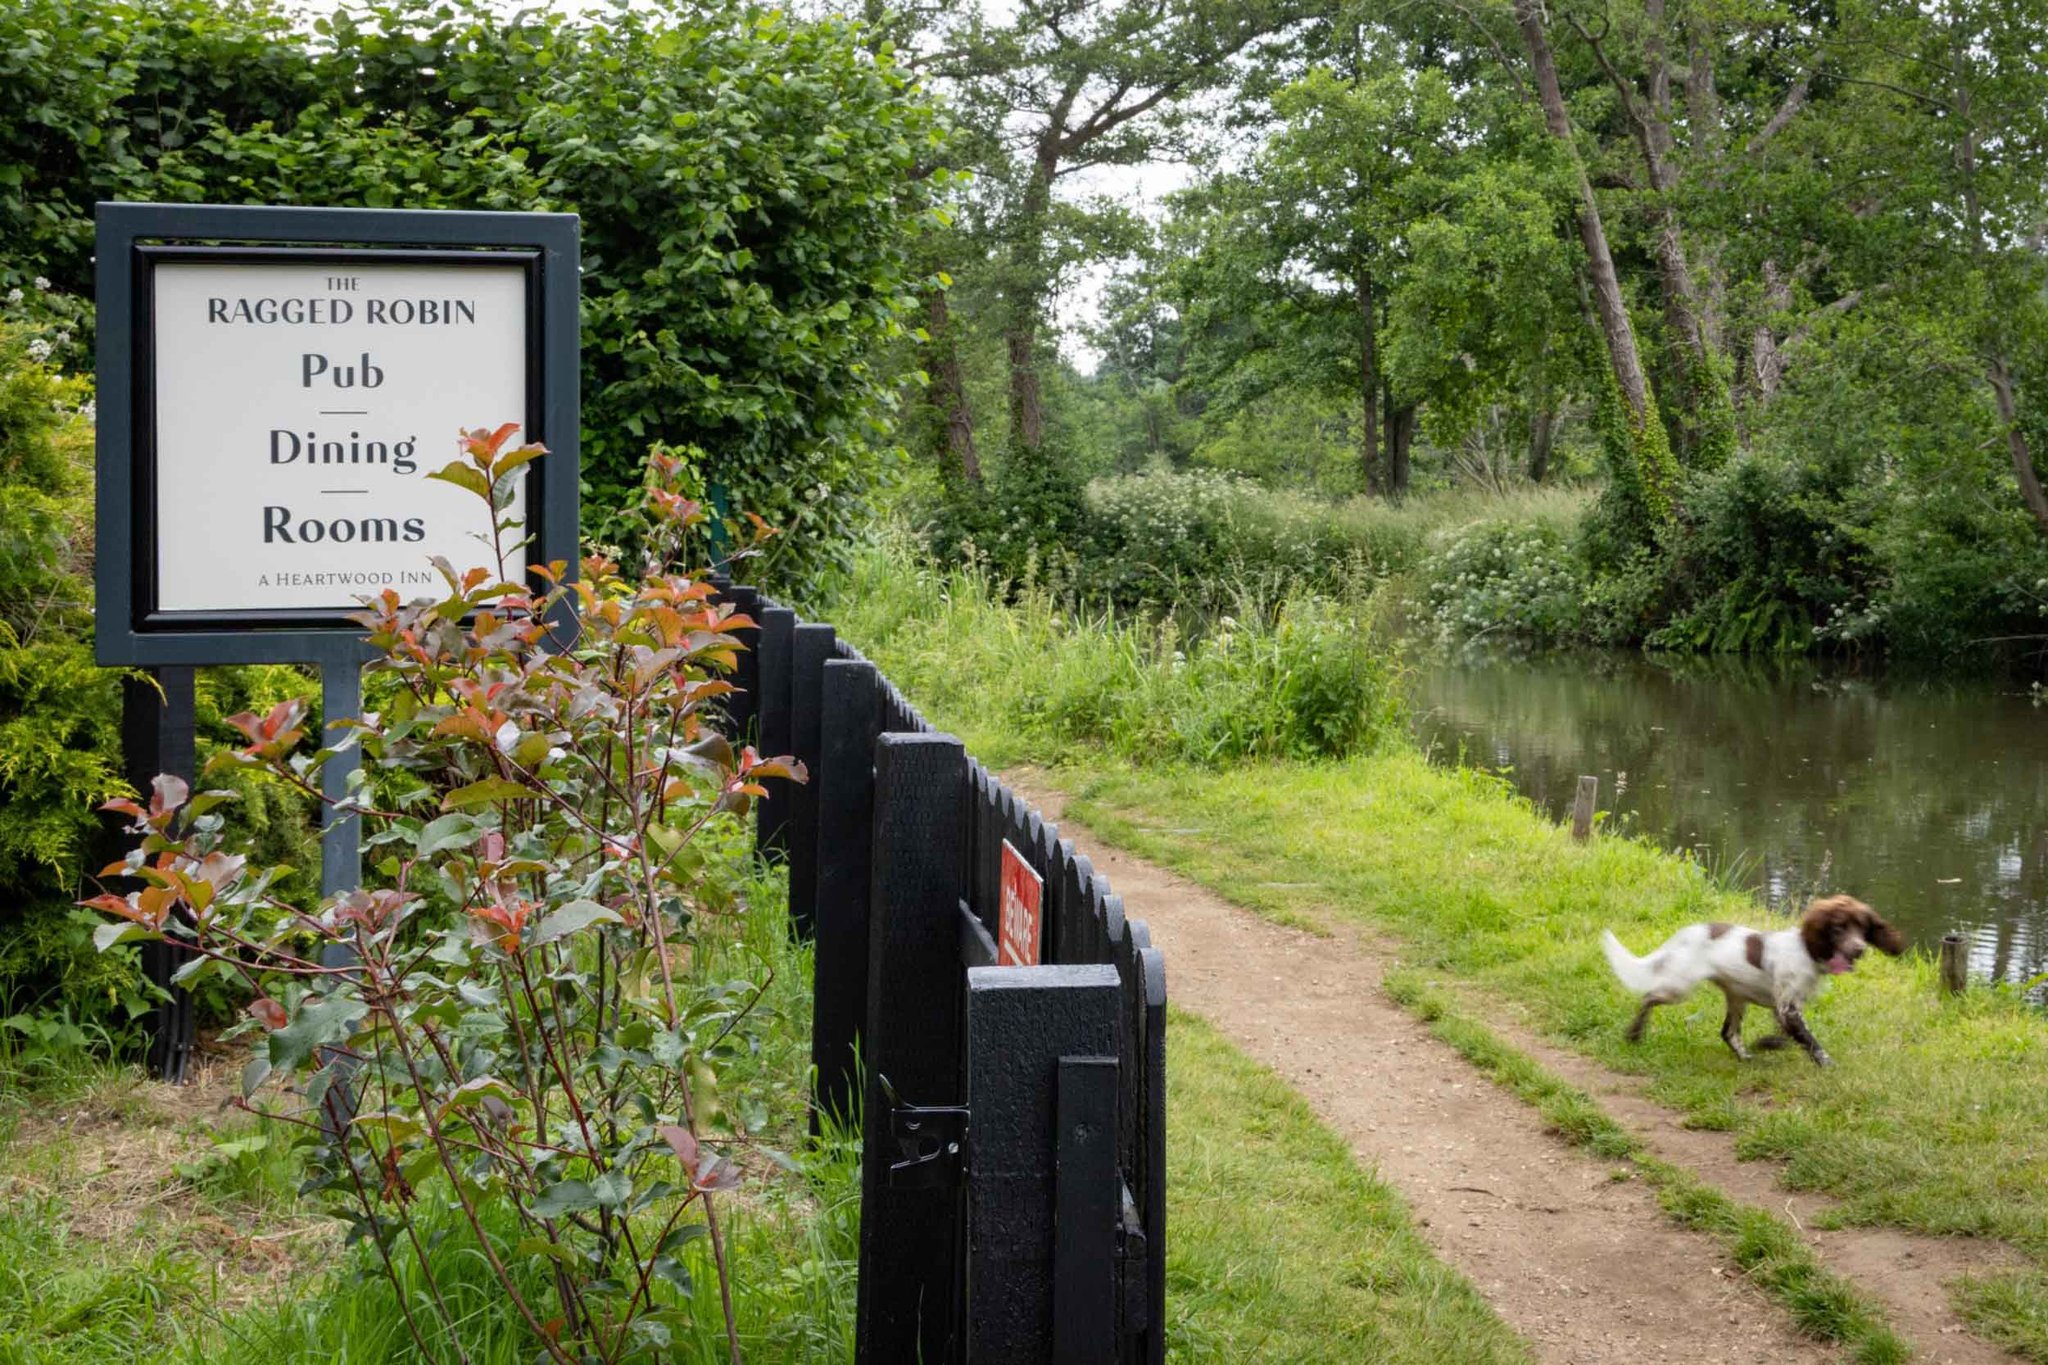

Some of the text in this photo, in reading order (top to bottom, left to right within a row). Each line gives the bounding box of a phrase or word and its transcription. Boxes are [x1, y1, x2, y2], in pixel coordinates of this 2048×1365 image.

[326, 277, 361, 291] THE
[208, 297, 475, 325] RAGGED ROBIN
[302, 352, 384, 389] Pub
[269, 429, 418, 475] Dining
[263, 505, 426, 544] Rooms
[258, 570, 433, 587] A HEARTWOOD INN
